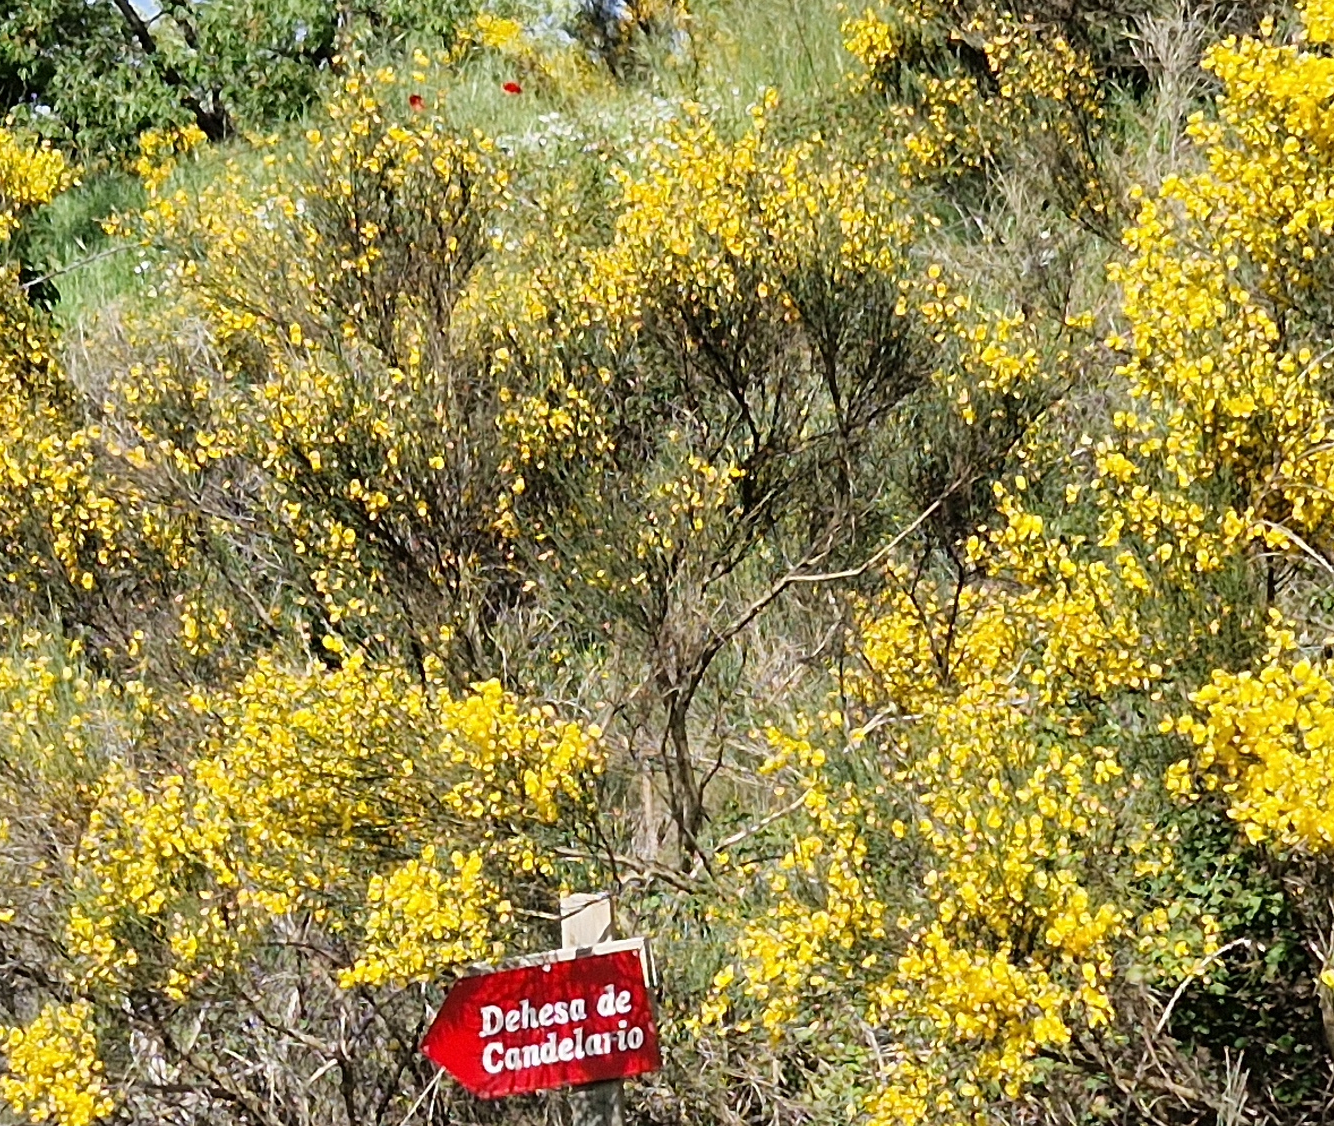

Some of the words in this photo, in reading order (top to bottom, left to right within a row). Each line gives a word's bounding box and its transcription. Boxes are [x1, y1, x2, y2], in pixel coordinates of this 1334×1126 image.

[479, 998, 588, 1037] Dehesa
[596, 984, 632, 1018] de
[482, 1020, 644, 1074] Candelario
